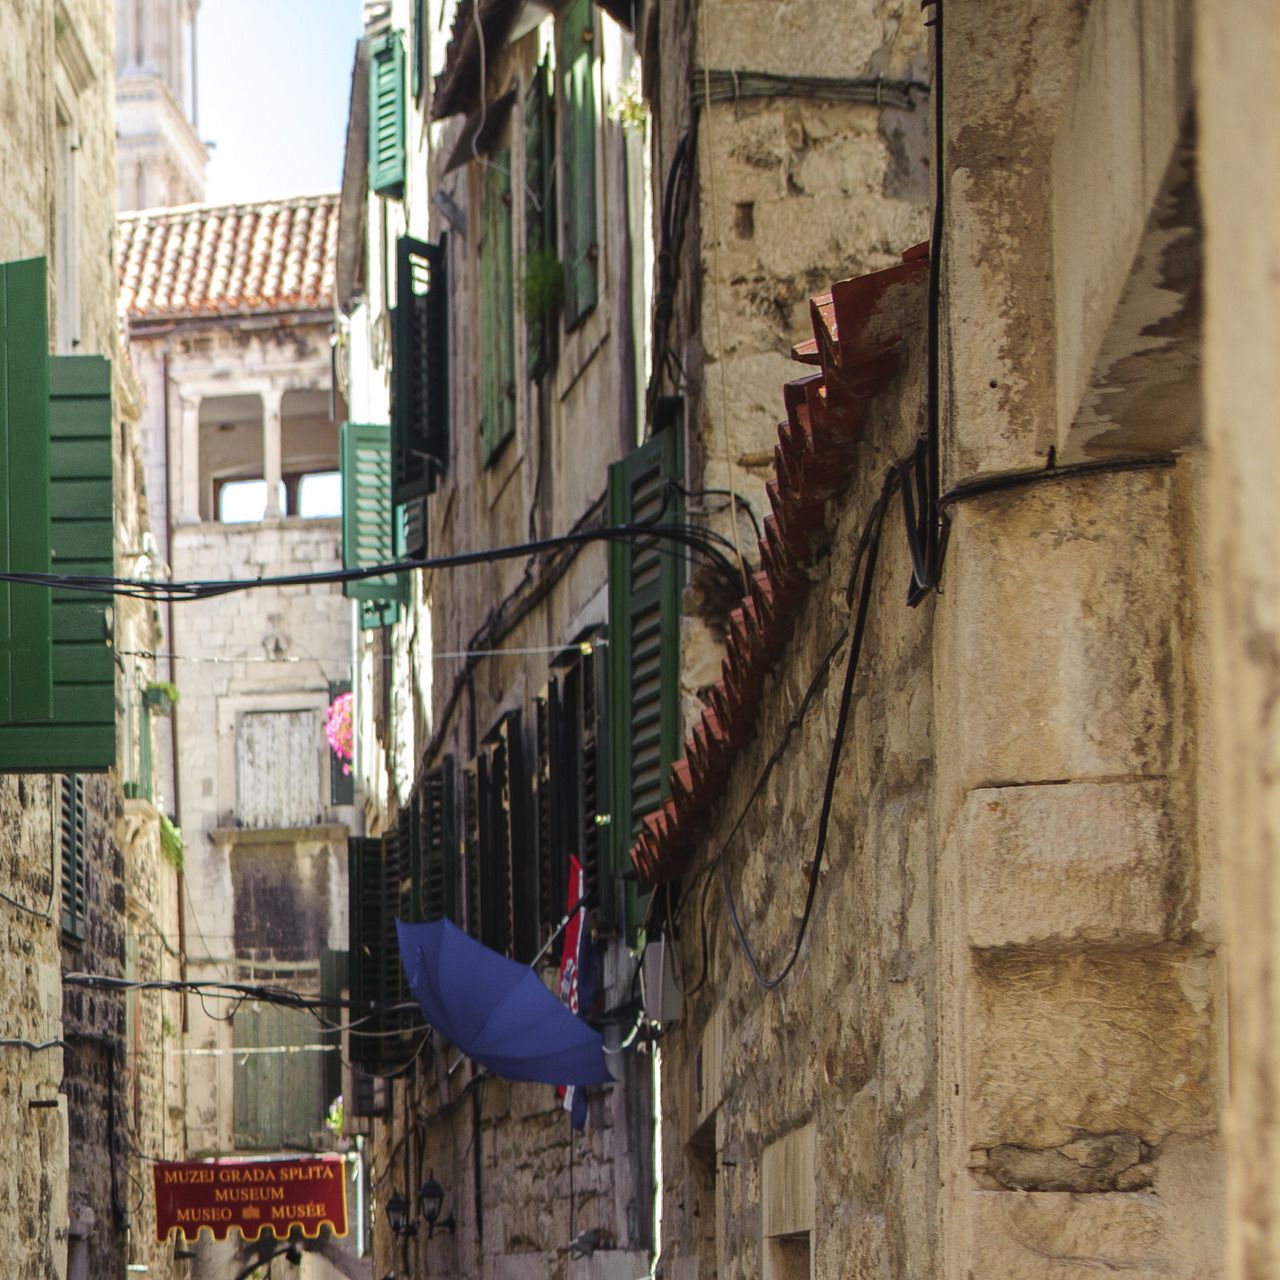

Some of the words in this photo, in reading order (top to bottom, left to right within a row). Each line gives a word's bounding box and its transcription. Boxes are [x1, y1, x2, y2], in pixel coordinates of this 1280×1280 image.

[164, 1169, 215, 1185] MUZEJ
[219, 1167, 276, 1183] GRADA
[280, 1165, 334, 1182] SPLITA
[215, 1187, 285, 1202] MUSEUM
[176, 1206, 232, 1222] MUSEO
[271, 1200, 327, 1219] MUSÉE
